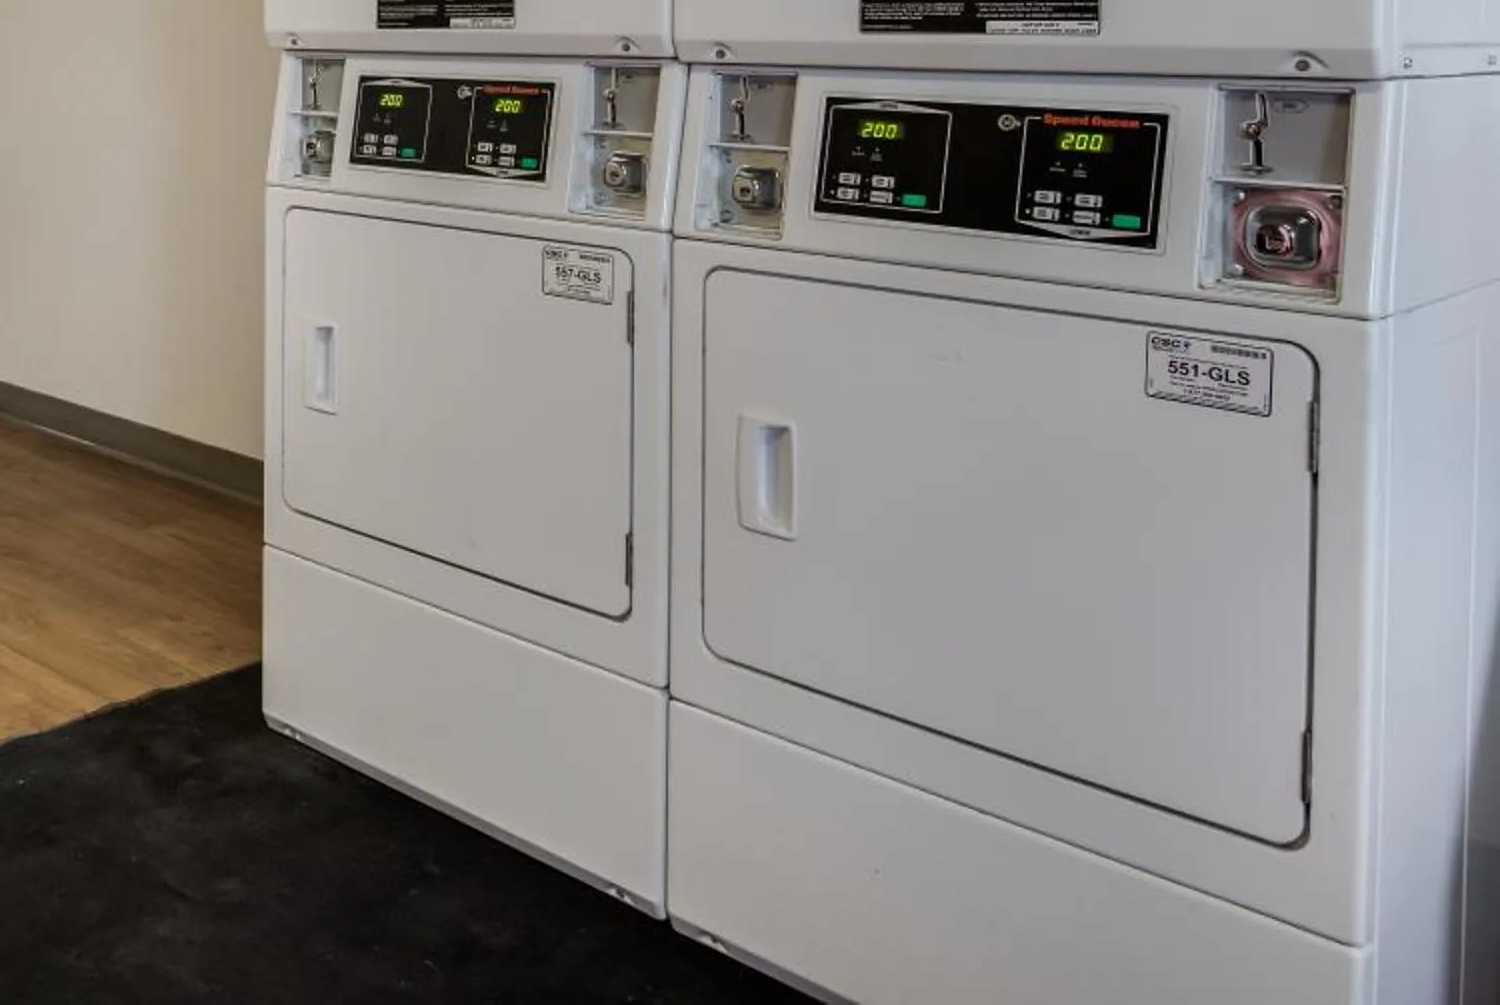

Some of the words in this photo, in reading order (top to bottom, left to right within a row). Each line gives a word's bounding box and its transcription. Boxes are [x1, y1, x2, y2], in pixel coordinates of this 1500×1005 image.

[495, 99, 521, 114] 200
[861, 122, 898, 139] 200
[1061, 132, 1103, 151] 200
[1167, 360, 1251, 386] 551-GLS
